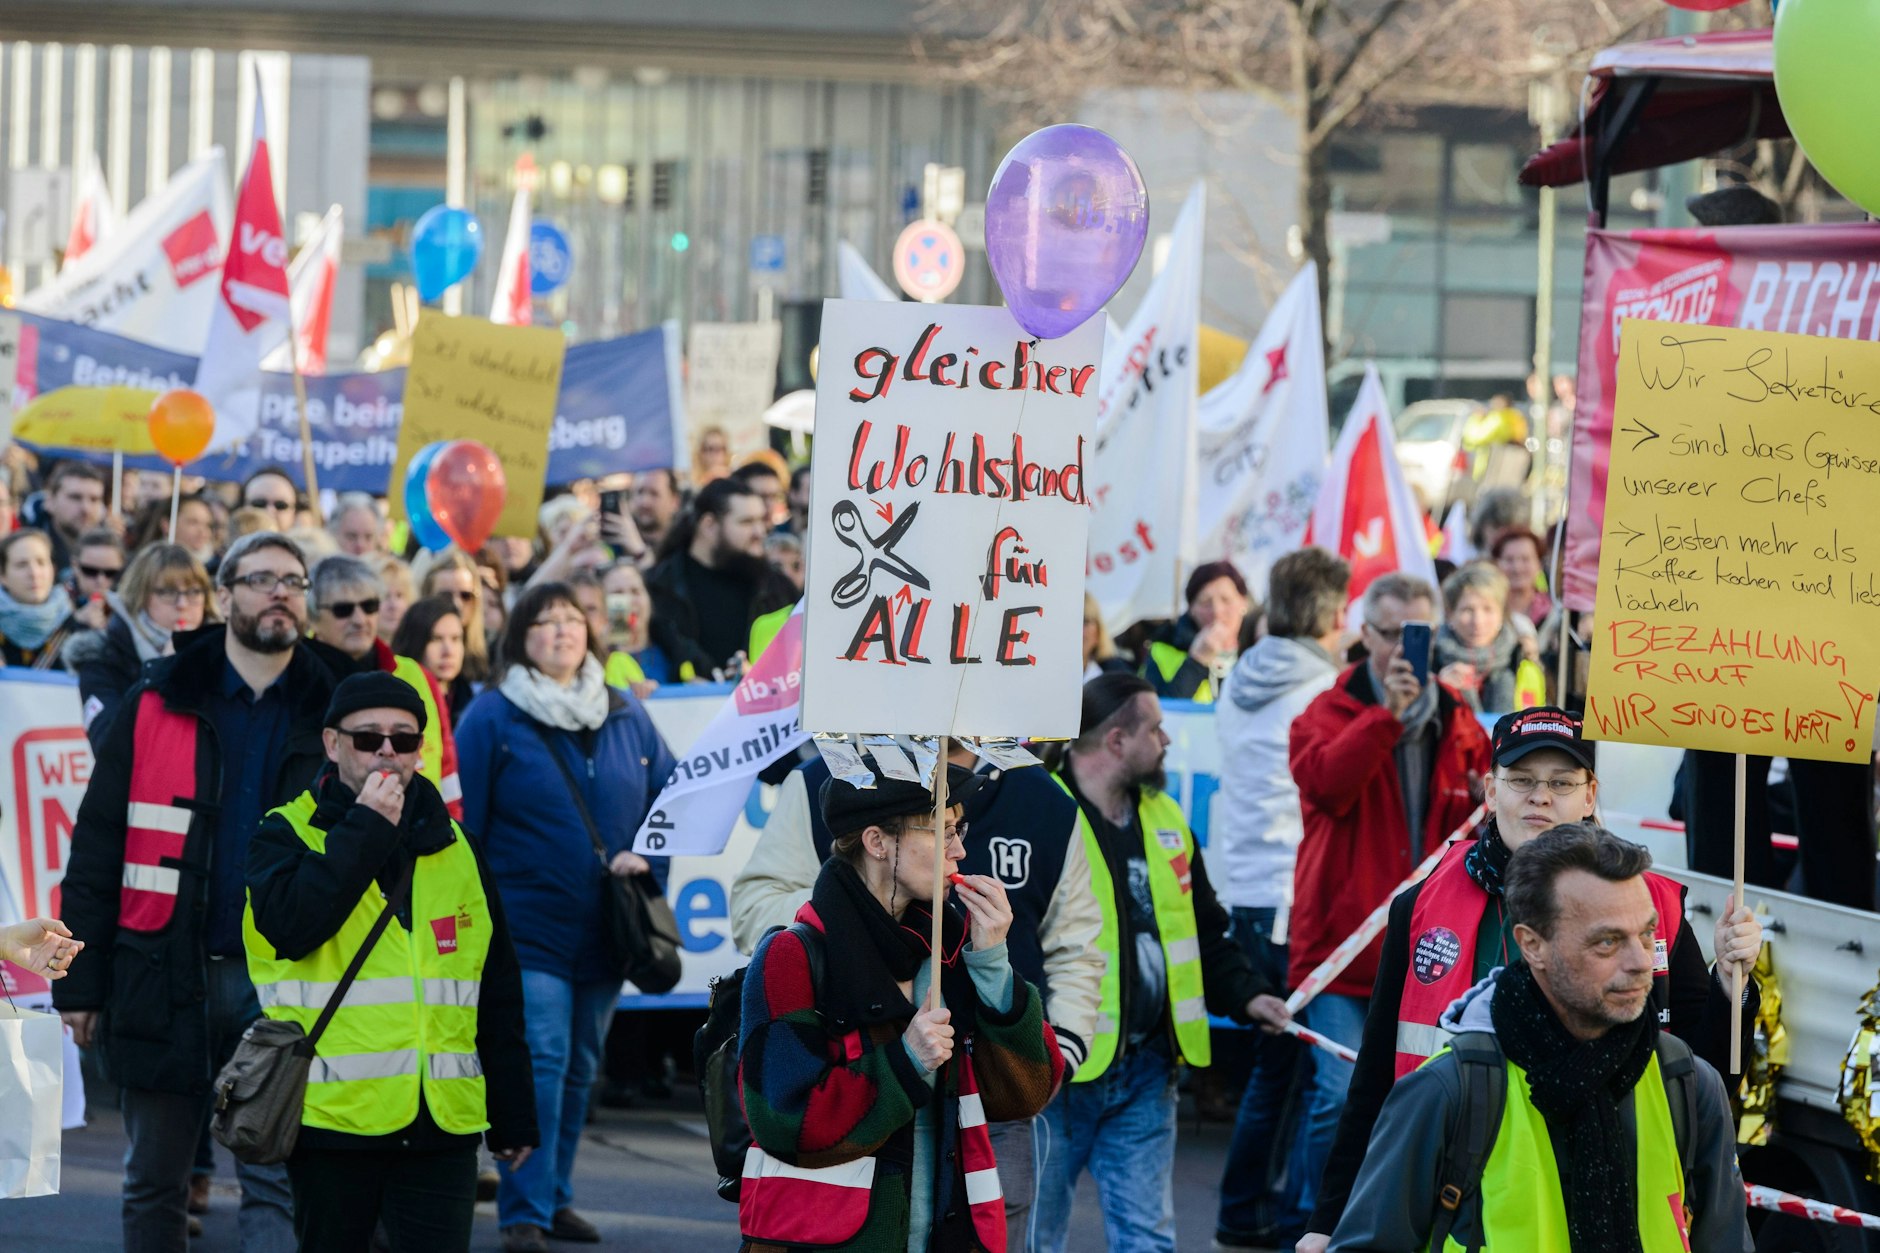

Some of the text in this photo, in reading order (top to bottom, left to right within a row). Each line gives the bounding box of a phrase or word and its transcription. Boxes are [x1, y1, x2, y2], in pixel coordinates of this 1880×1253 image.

[1637, 335, 1727, 390] Wir
[1742, 424, 1793, 460] das
[1804, 431, 1880, 479] Gewisse
[1623, 473, 1827, 515] unserer Chefs
[1656, 513, 1857, 563] leisten mehr als
[1614, 554, 1704, 585] Kaffee
[1615, 584, 1699, 612] lächeln
[836, 594, 1044, 667] ALLE
[1608, 620, 1846, 676] BEZAHLUNG
[1613, 660, 1754, 686] RAUF
[1521, 721, 1574, 737] Mindestlohn
[1591, 692, 1669, 738] WIR
